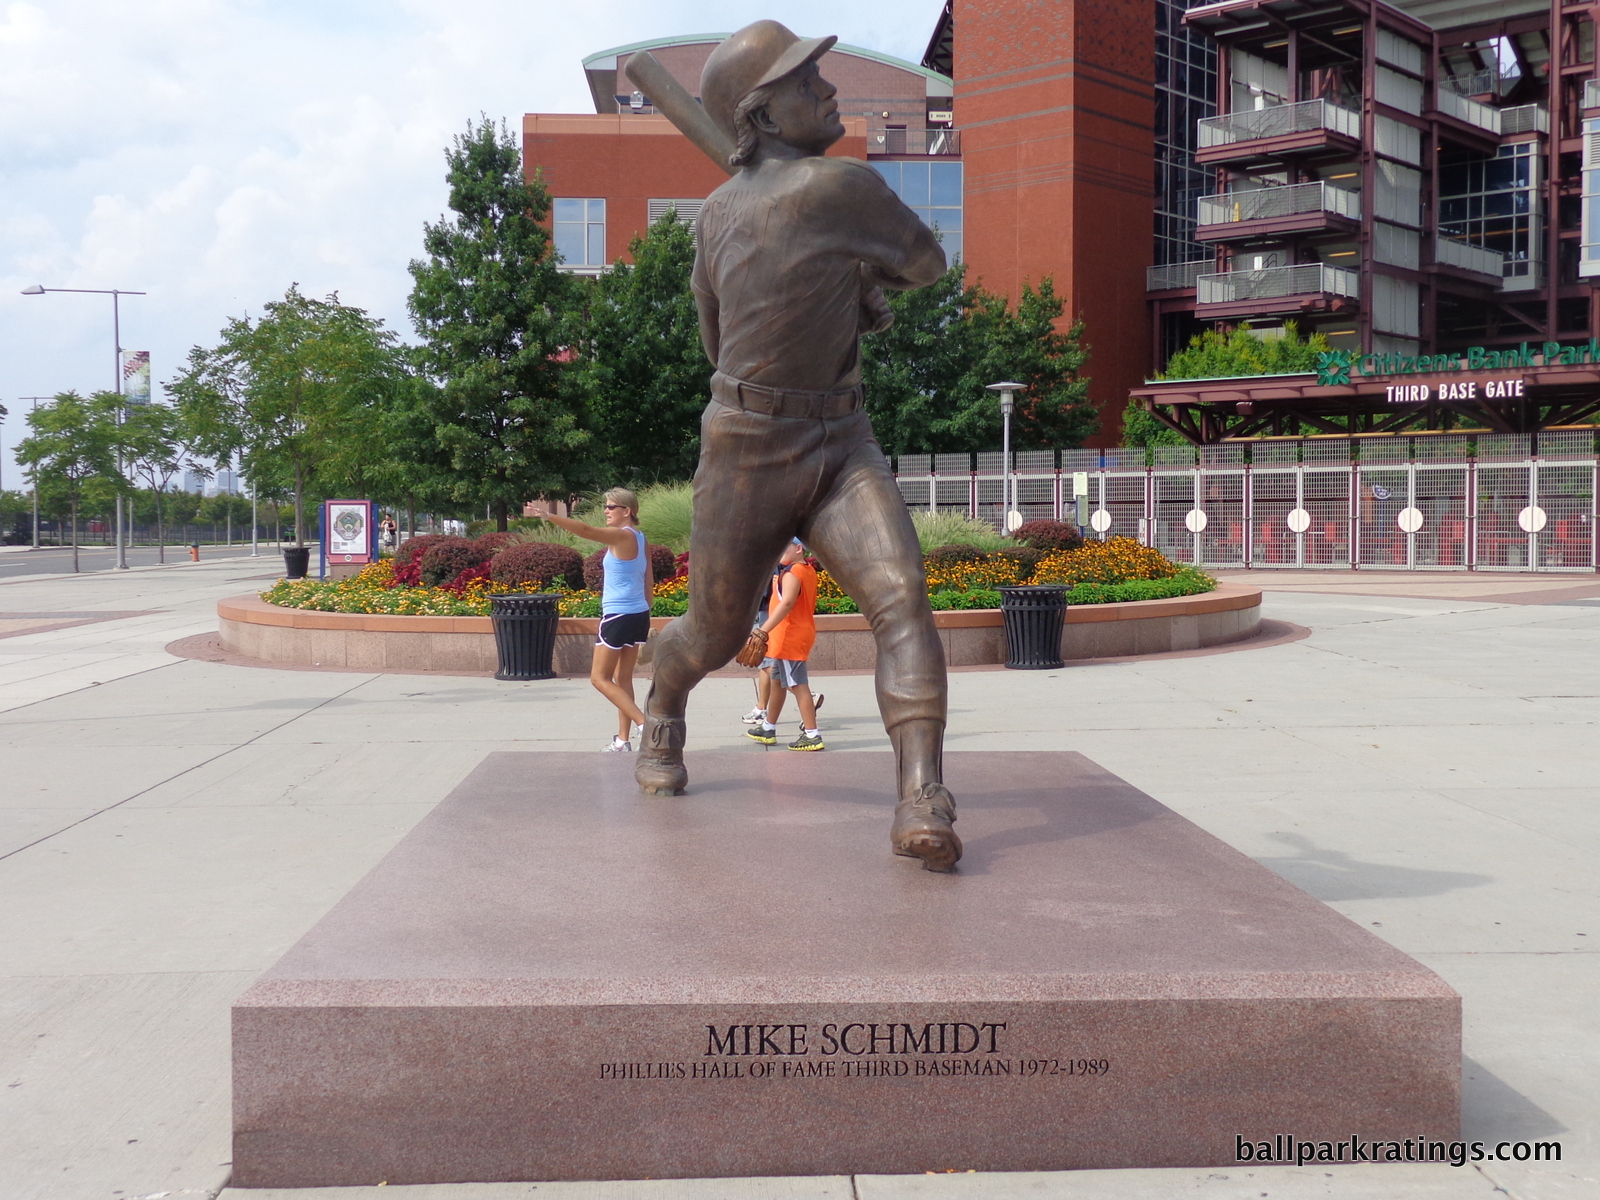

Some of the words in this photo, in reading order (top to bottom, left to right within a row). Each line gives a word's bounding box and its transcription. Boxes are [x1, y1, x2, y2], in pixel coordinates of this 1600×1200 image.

[1357, 350, 1461, 376] Citizens
[1467, 341, 1537, 370] Bank
[1386, 384, 1429, 403] THIRD
[1438, 382, 1476, 400] BASE
[1485, 379, 1524, 398] GATE
[704, 1024, 809, 1056] MIKE
[821, 1022, 1007, 1056] SCHMIDT
[600, 1062, 686, 1080] PHILLIES
[692, 1062, 745, 1079] HALL
[750, 1062, 776, 1078] OF
[782, 1061, 837, 1079] FAME
[842, 1060, 909, 1077] THIRD
[915, 1059, 1011, 1077] BASEMAN
[1019, 1058, 1109, 1077] 1972-1989
